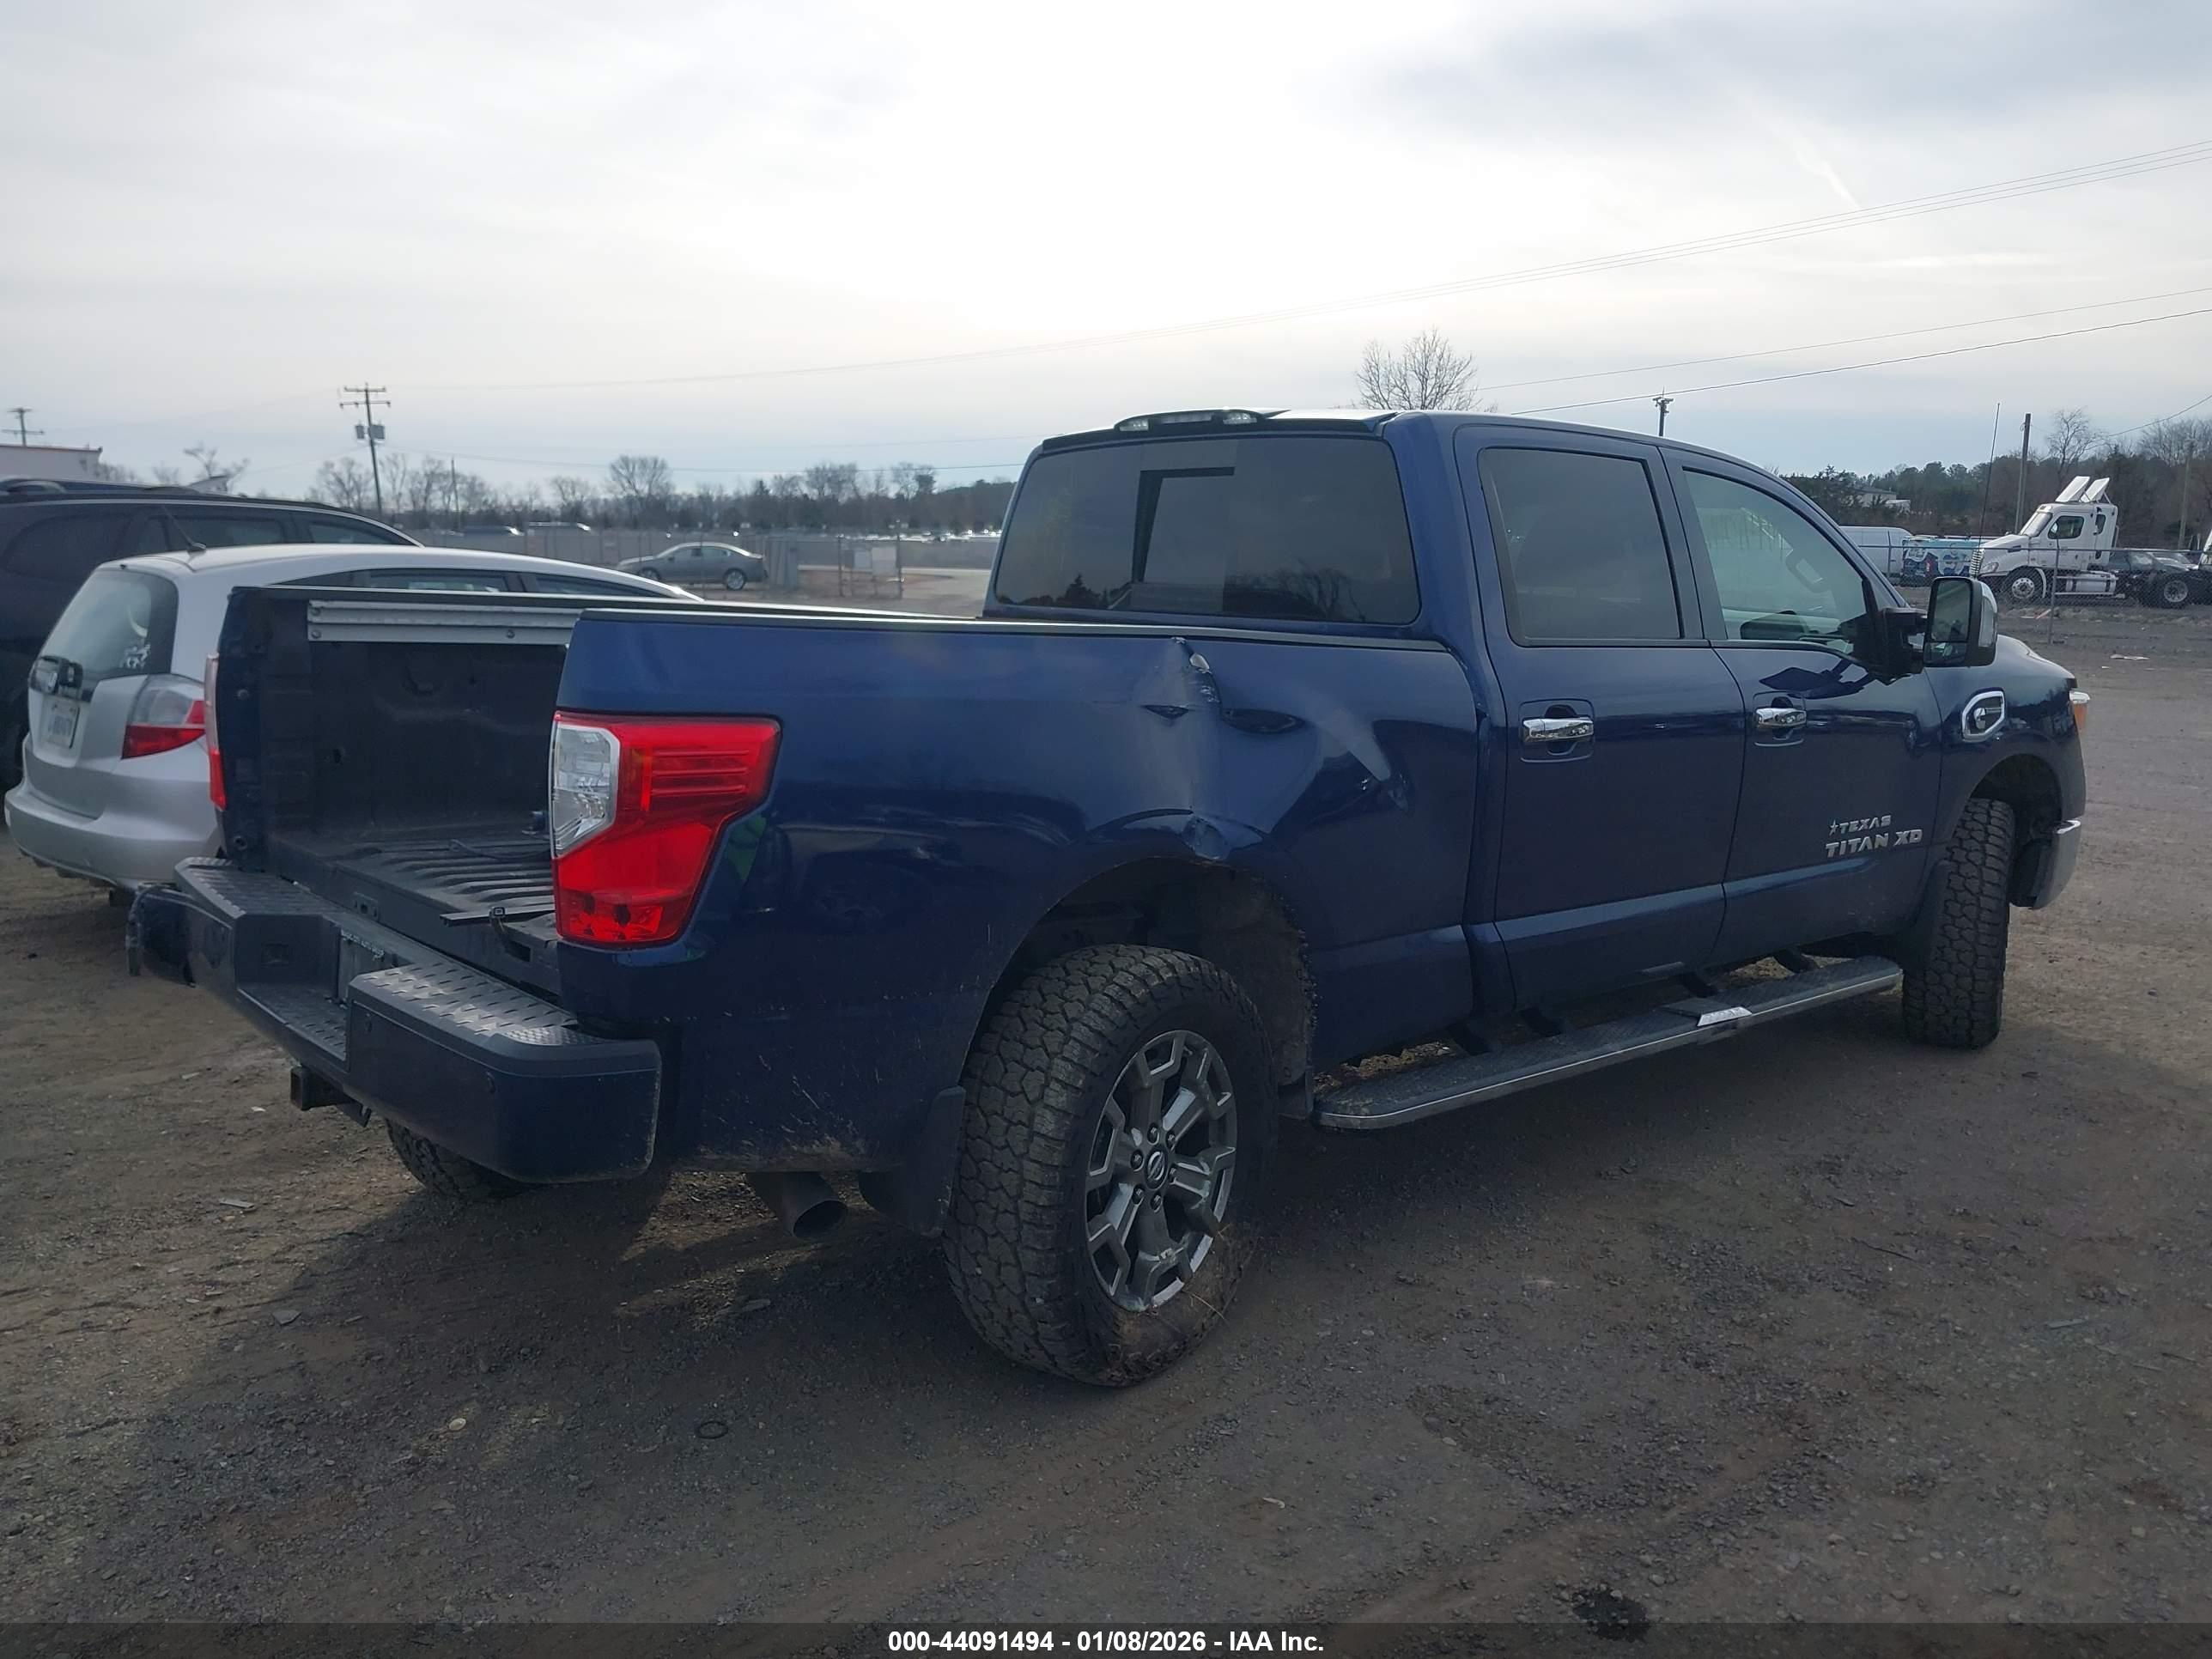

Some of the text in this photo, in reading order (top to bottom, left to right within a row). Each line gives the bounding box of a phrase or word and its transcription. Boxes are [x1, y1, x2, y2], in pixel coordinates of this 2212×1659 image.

[1839, 815, 1892, 835] TEXAS
[1826, 829, 1923, 858] TITAN XD
